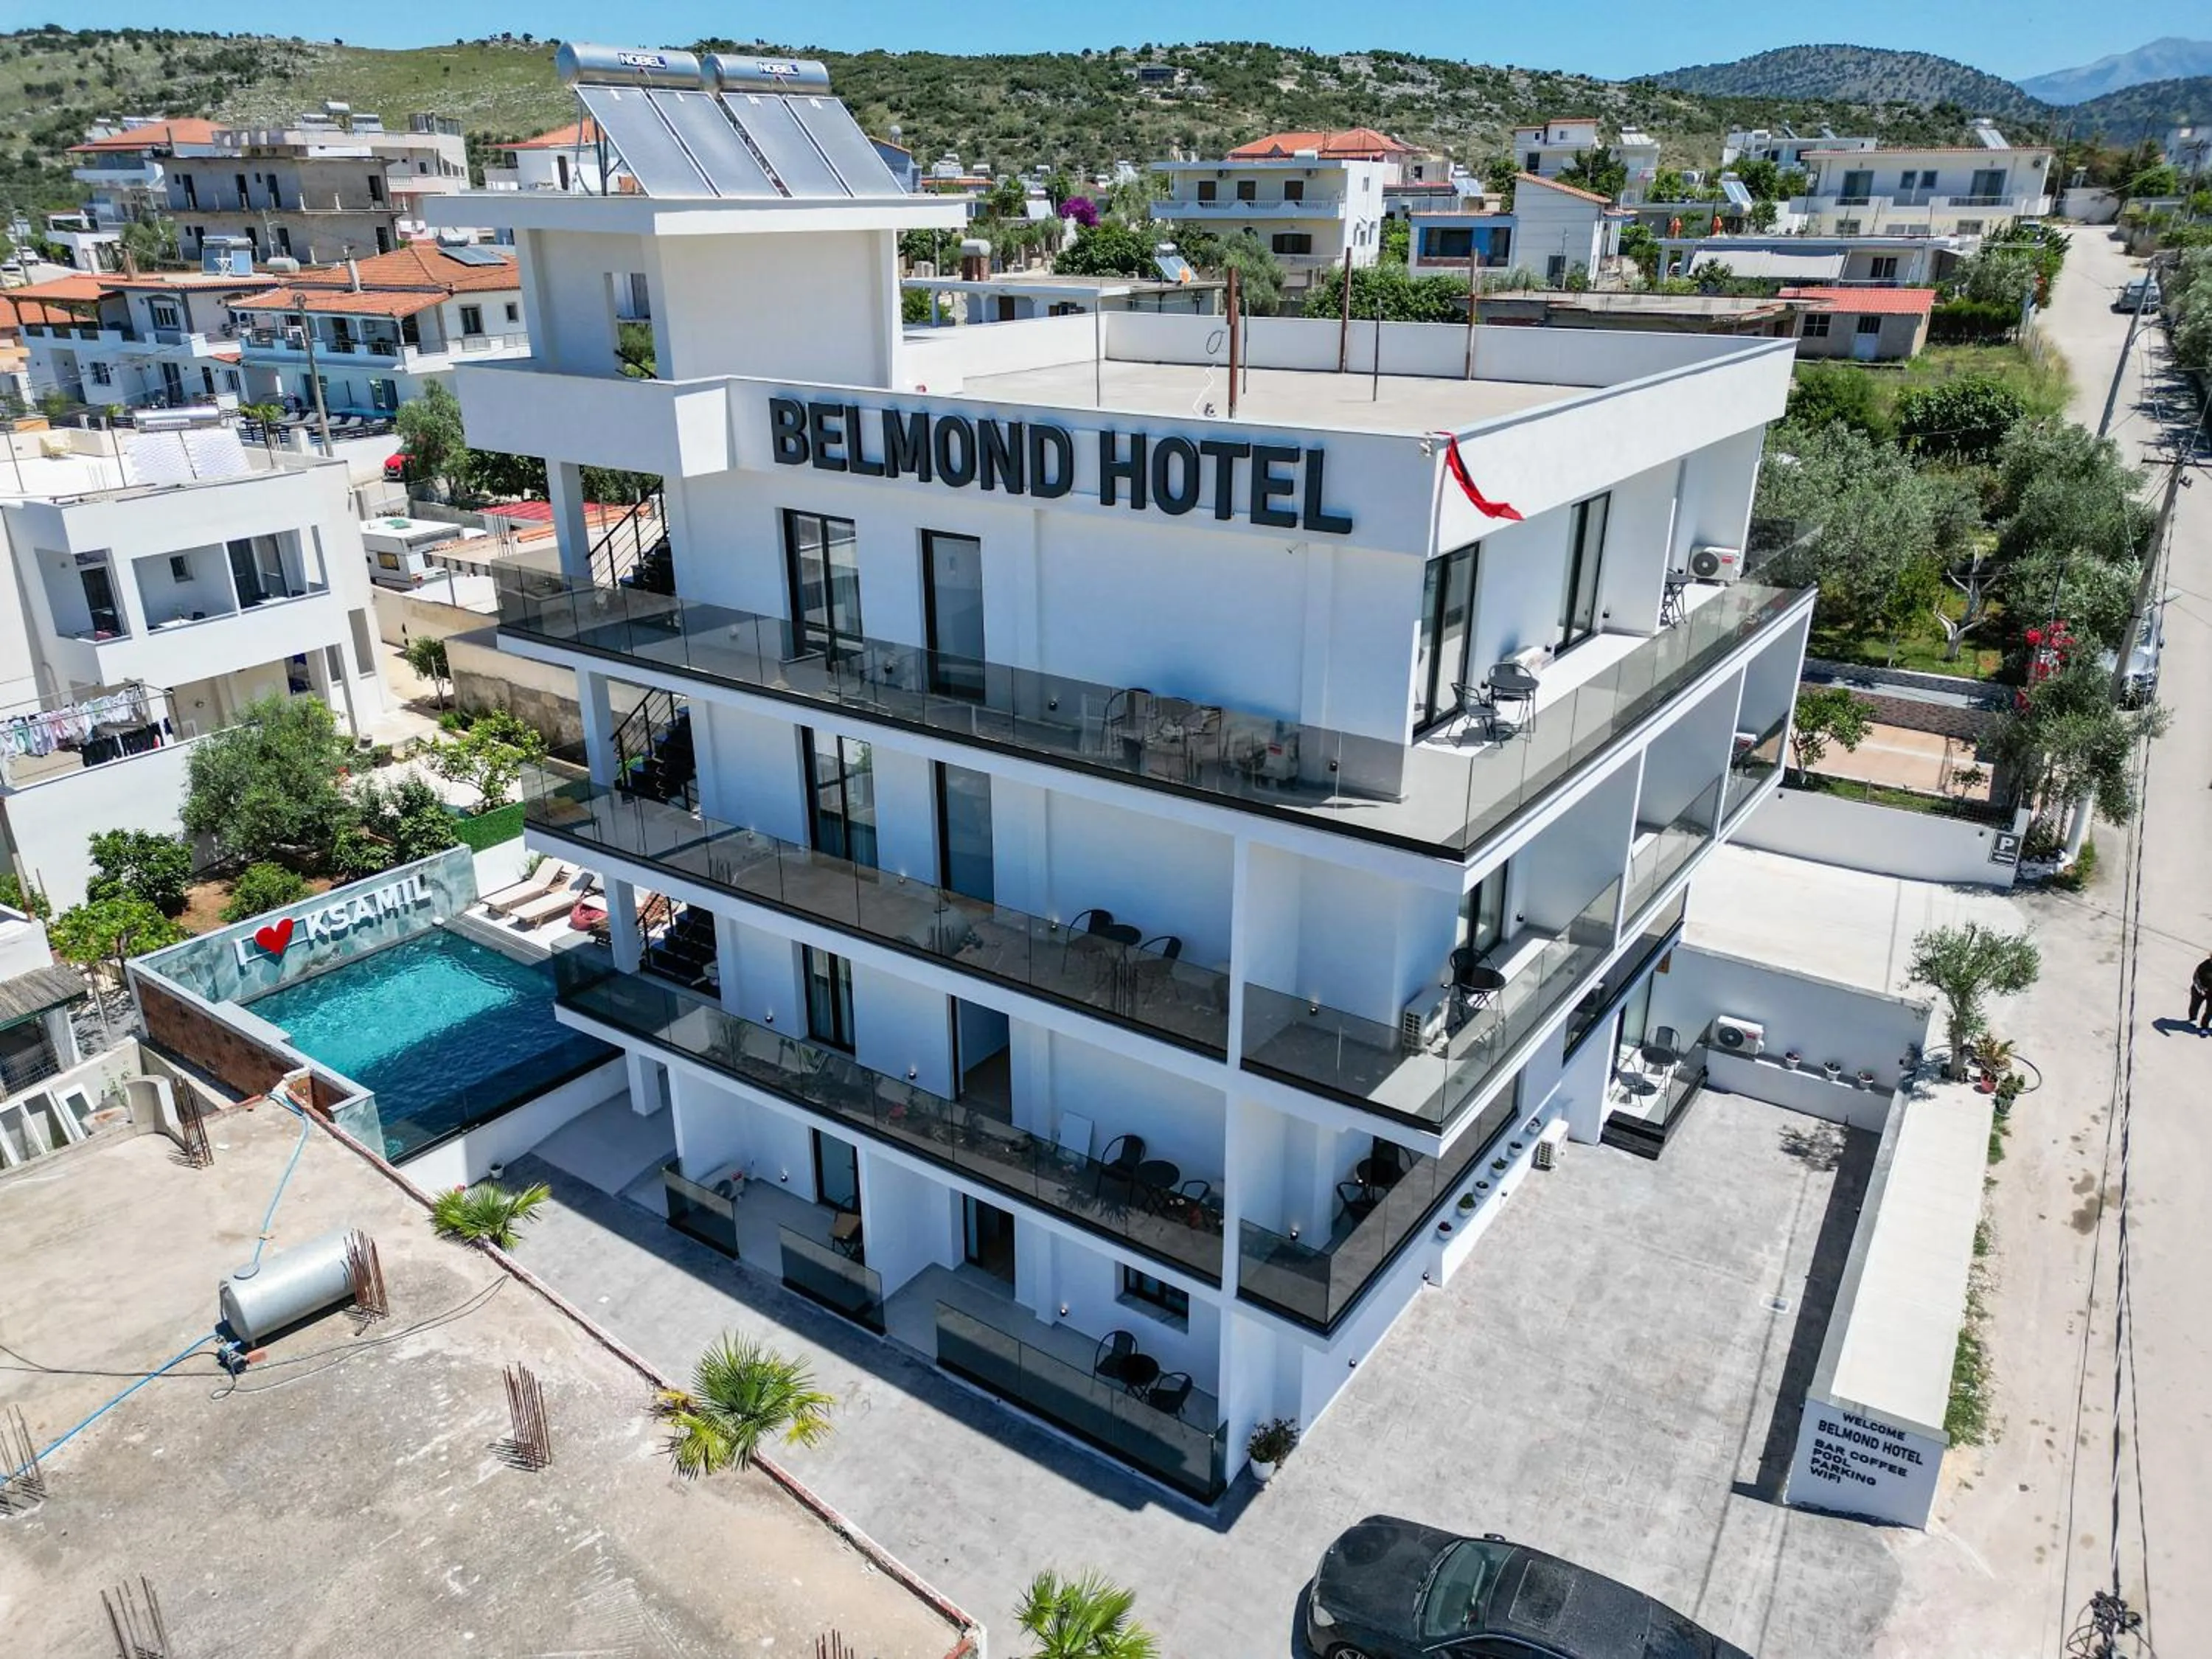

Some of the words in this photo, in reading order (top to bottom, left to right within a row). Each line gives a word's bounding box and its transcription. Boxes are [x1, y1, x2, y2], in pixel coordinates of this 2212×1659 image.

[619, 54, 666, 68] NOBEL
[769, 397, 1074, 498] BELMOND
[1100, 430, 1352, 534] HOTEL
[1999, 837, 2014, 850] P
[234, 939, 246, 966] I
[305, 875, 433, 941] KSAMIL
[1843, 1413, 1906, 1441] WELCOME
[1818, 1419, 1879, 1450] BELMOND
[1882, 1441, 1923, 1465] HOTEL
[1811, 1458, 1877, 1486] PARKING
[1812, 1448, 1851, 1468] POOL
[1815, 1439, 1845, 1456] BAR
[1849, 1450, 1907, 1477] COFFEE
[1810, 1467, 1841, 1484] WIFI
